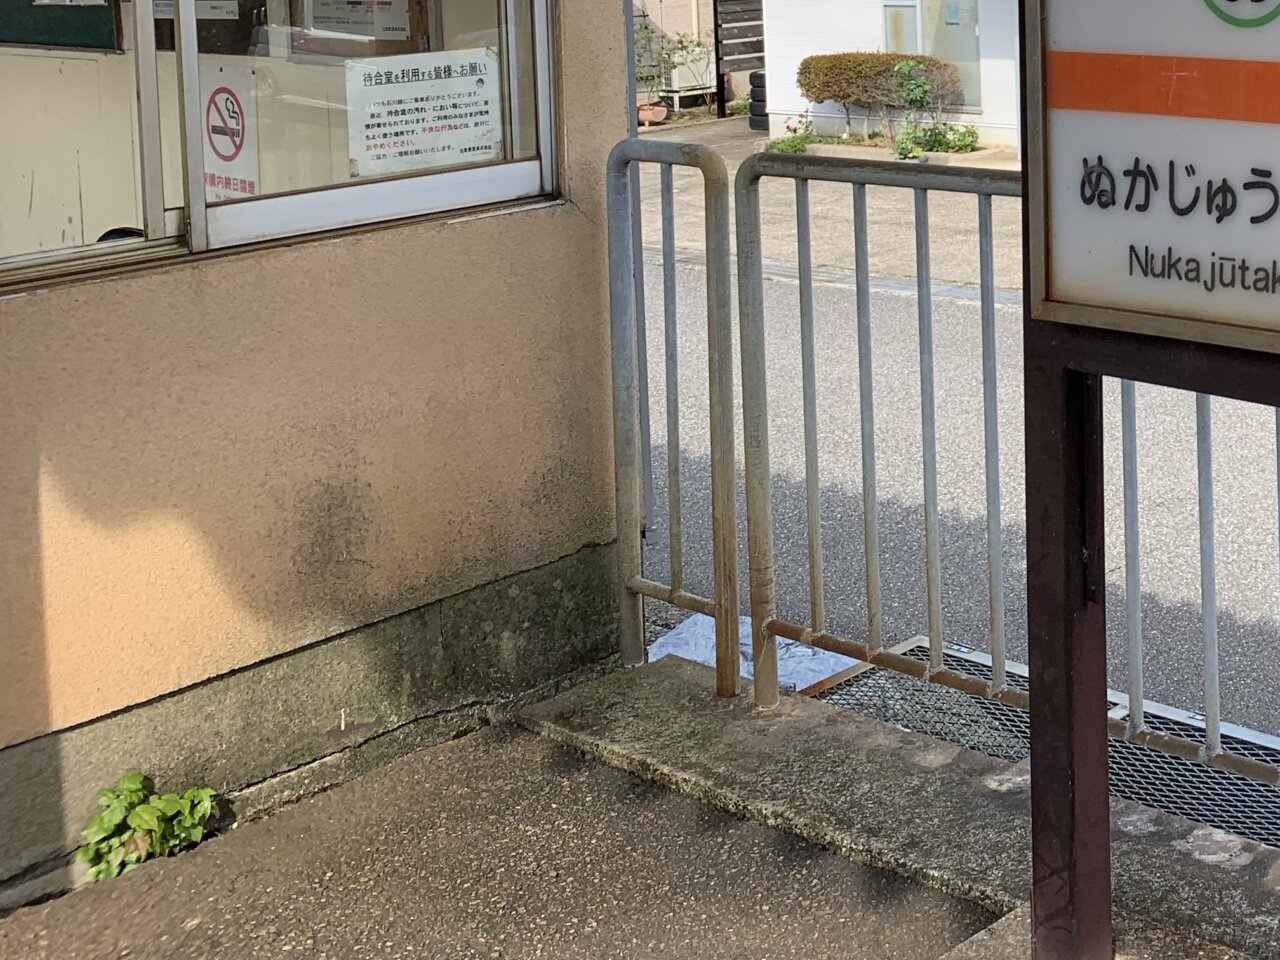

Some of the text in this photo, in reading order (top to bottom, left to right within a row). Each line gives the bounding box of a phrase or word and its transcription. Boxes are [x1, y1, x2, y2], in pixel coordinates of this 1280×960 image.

[362, 62, 488, 86] 待合室を利用する皆様へお願い
